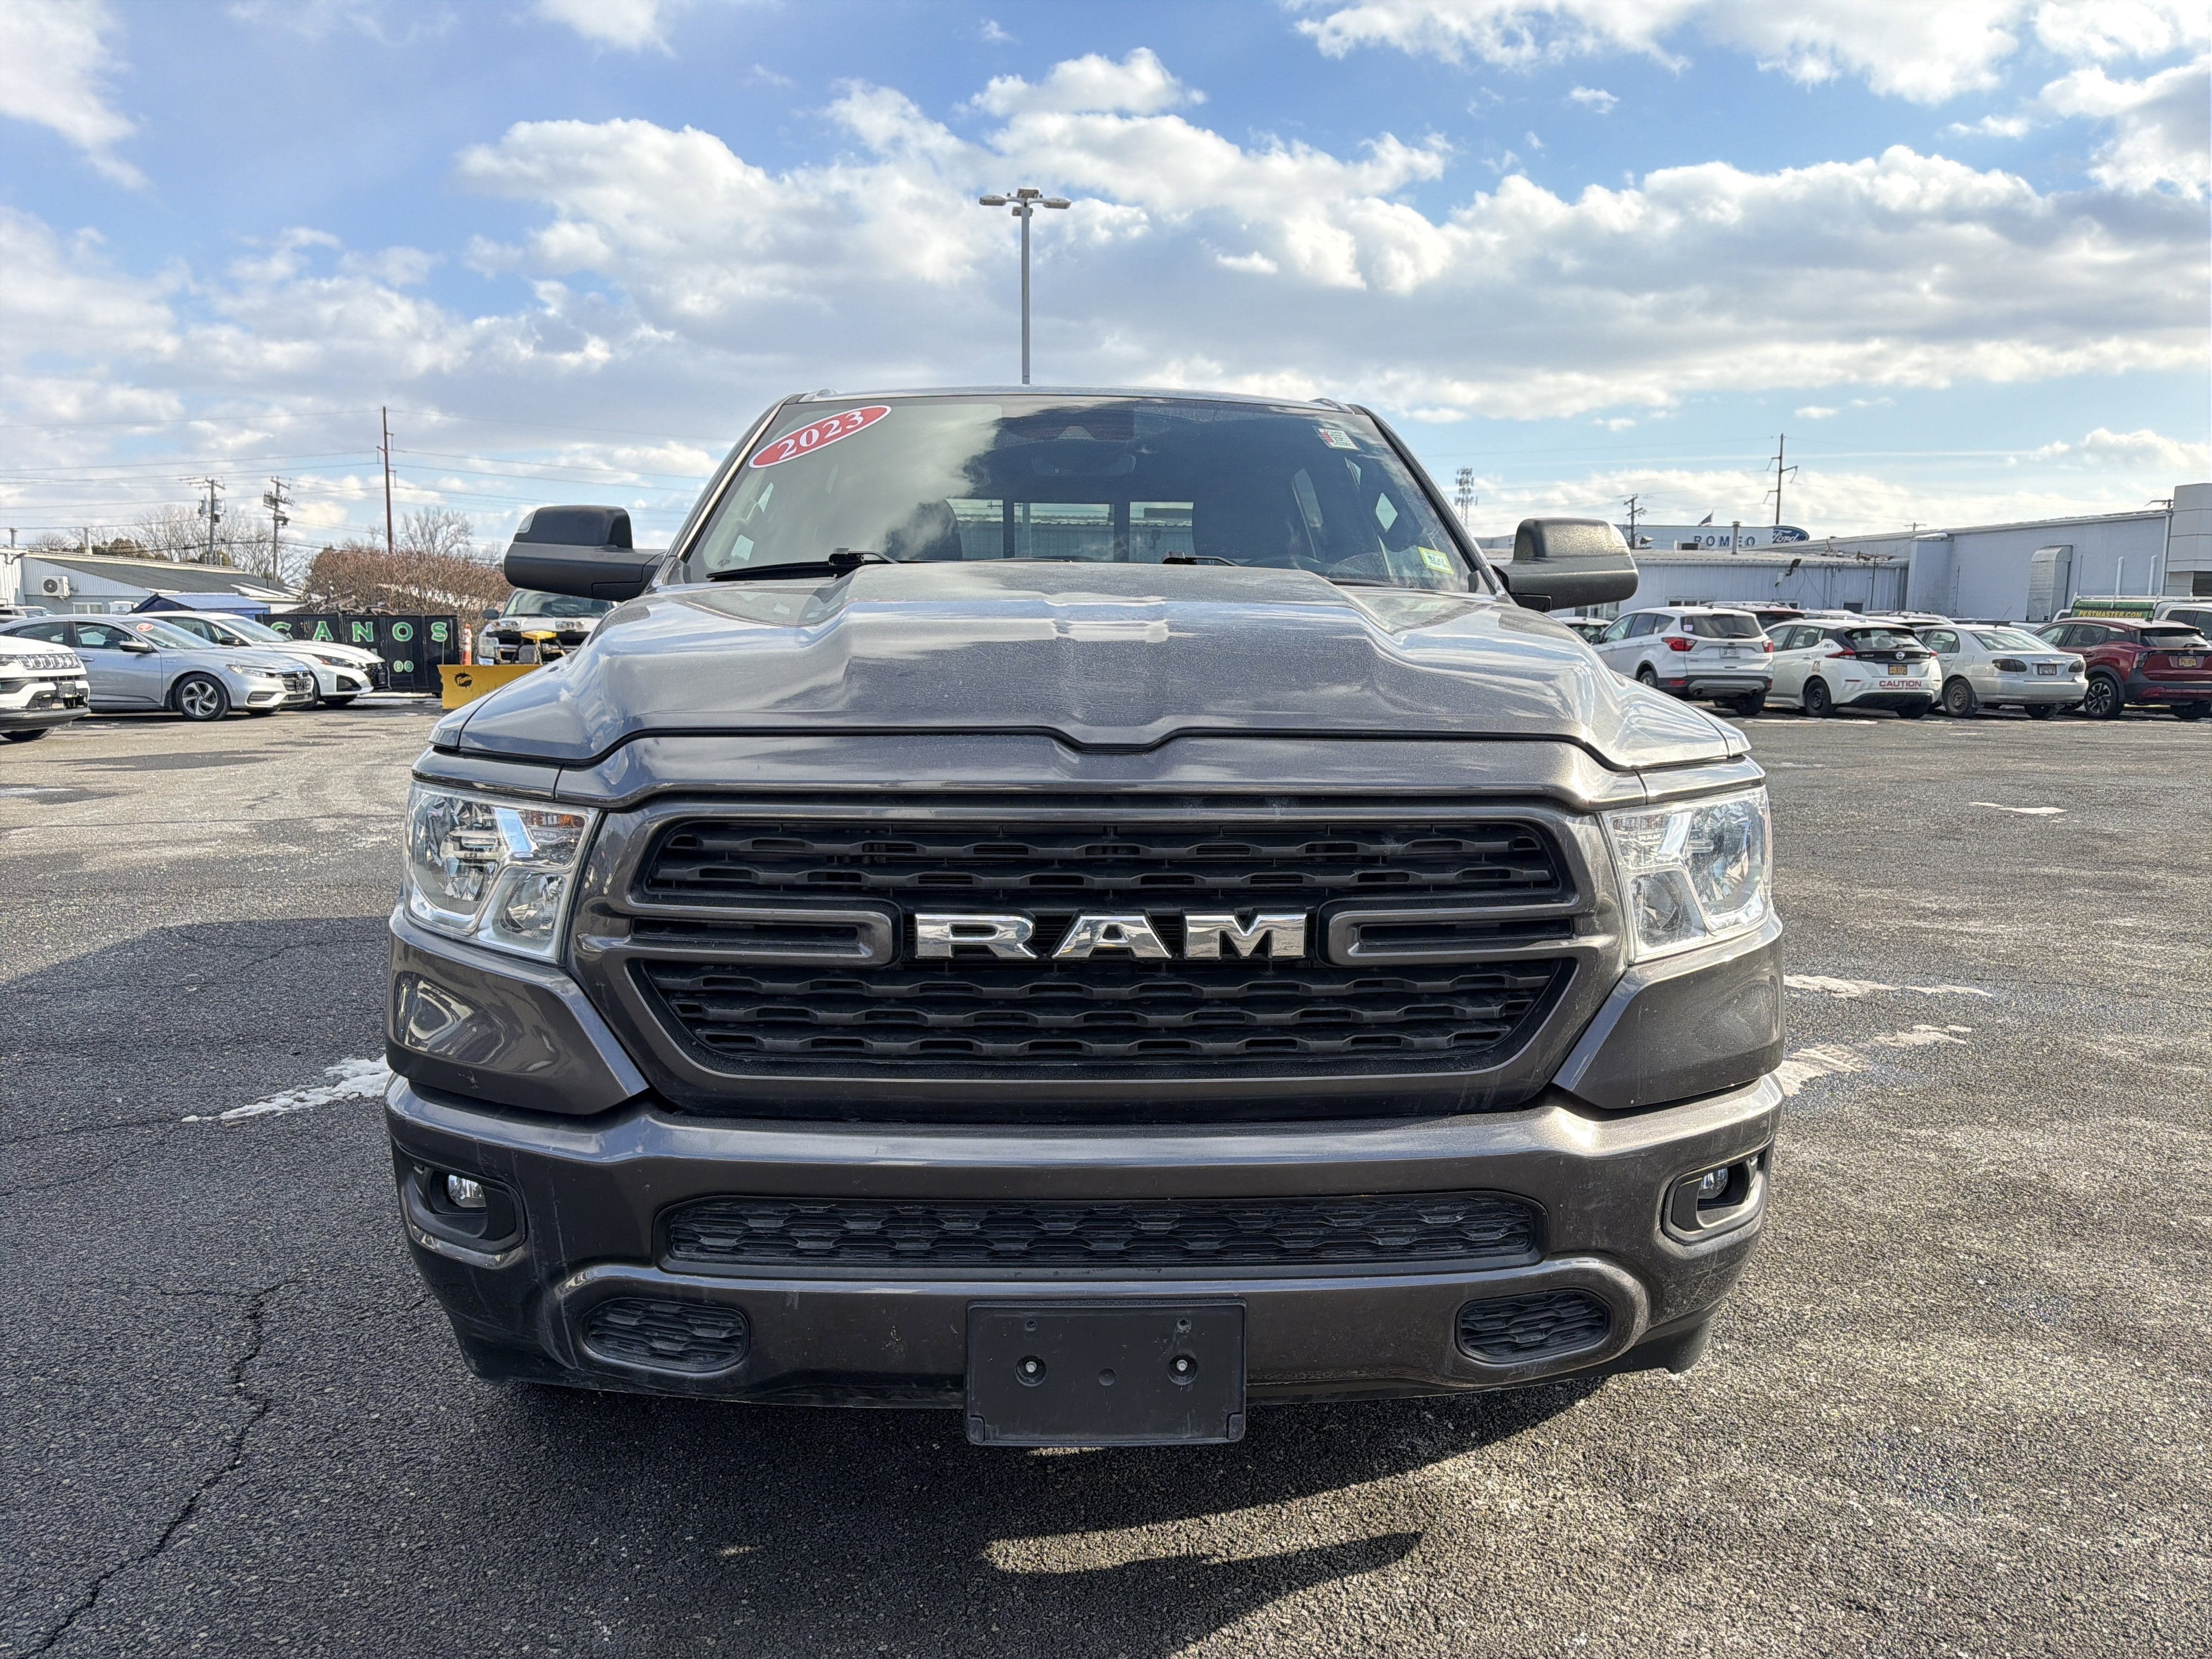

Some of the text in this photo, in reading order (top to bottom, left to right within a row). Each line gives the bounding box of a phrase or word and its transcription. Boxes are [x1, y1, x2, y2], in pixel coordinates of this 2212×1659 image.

[777, 411, 864, 460] 2023
[1772, 529, 1801, 543] Ford
[2079, 610, 2143, 618] PESTMASTER.COM
[915, 913, 1307, 959] RAM
